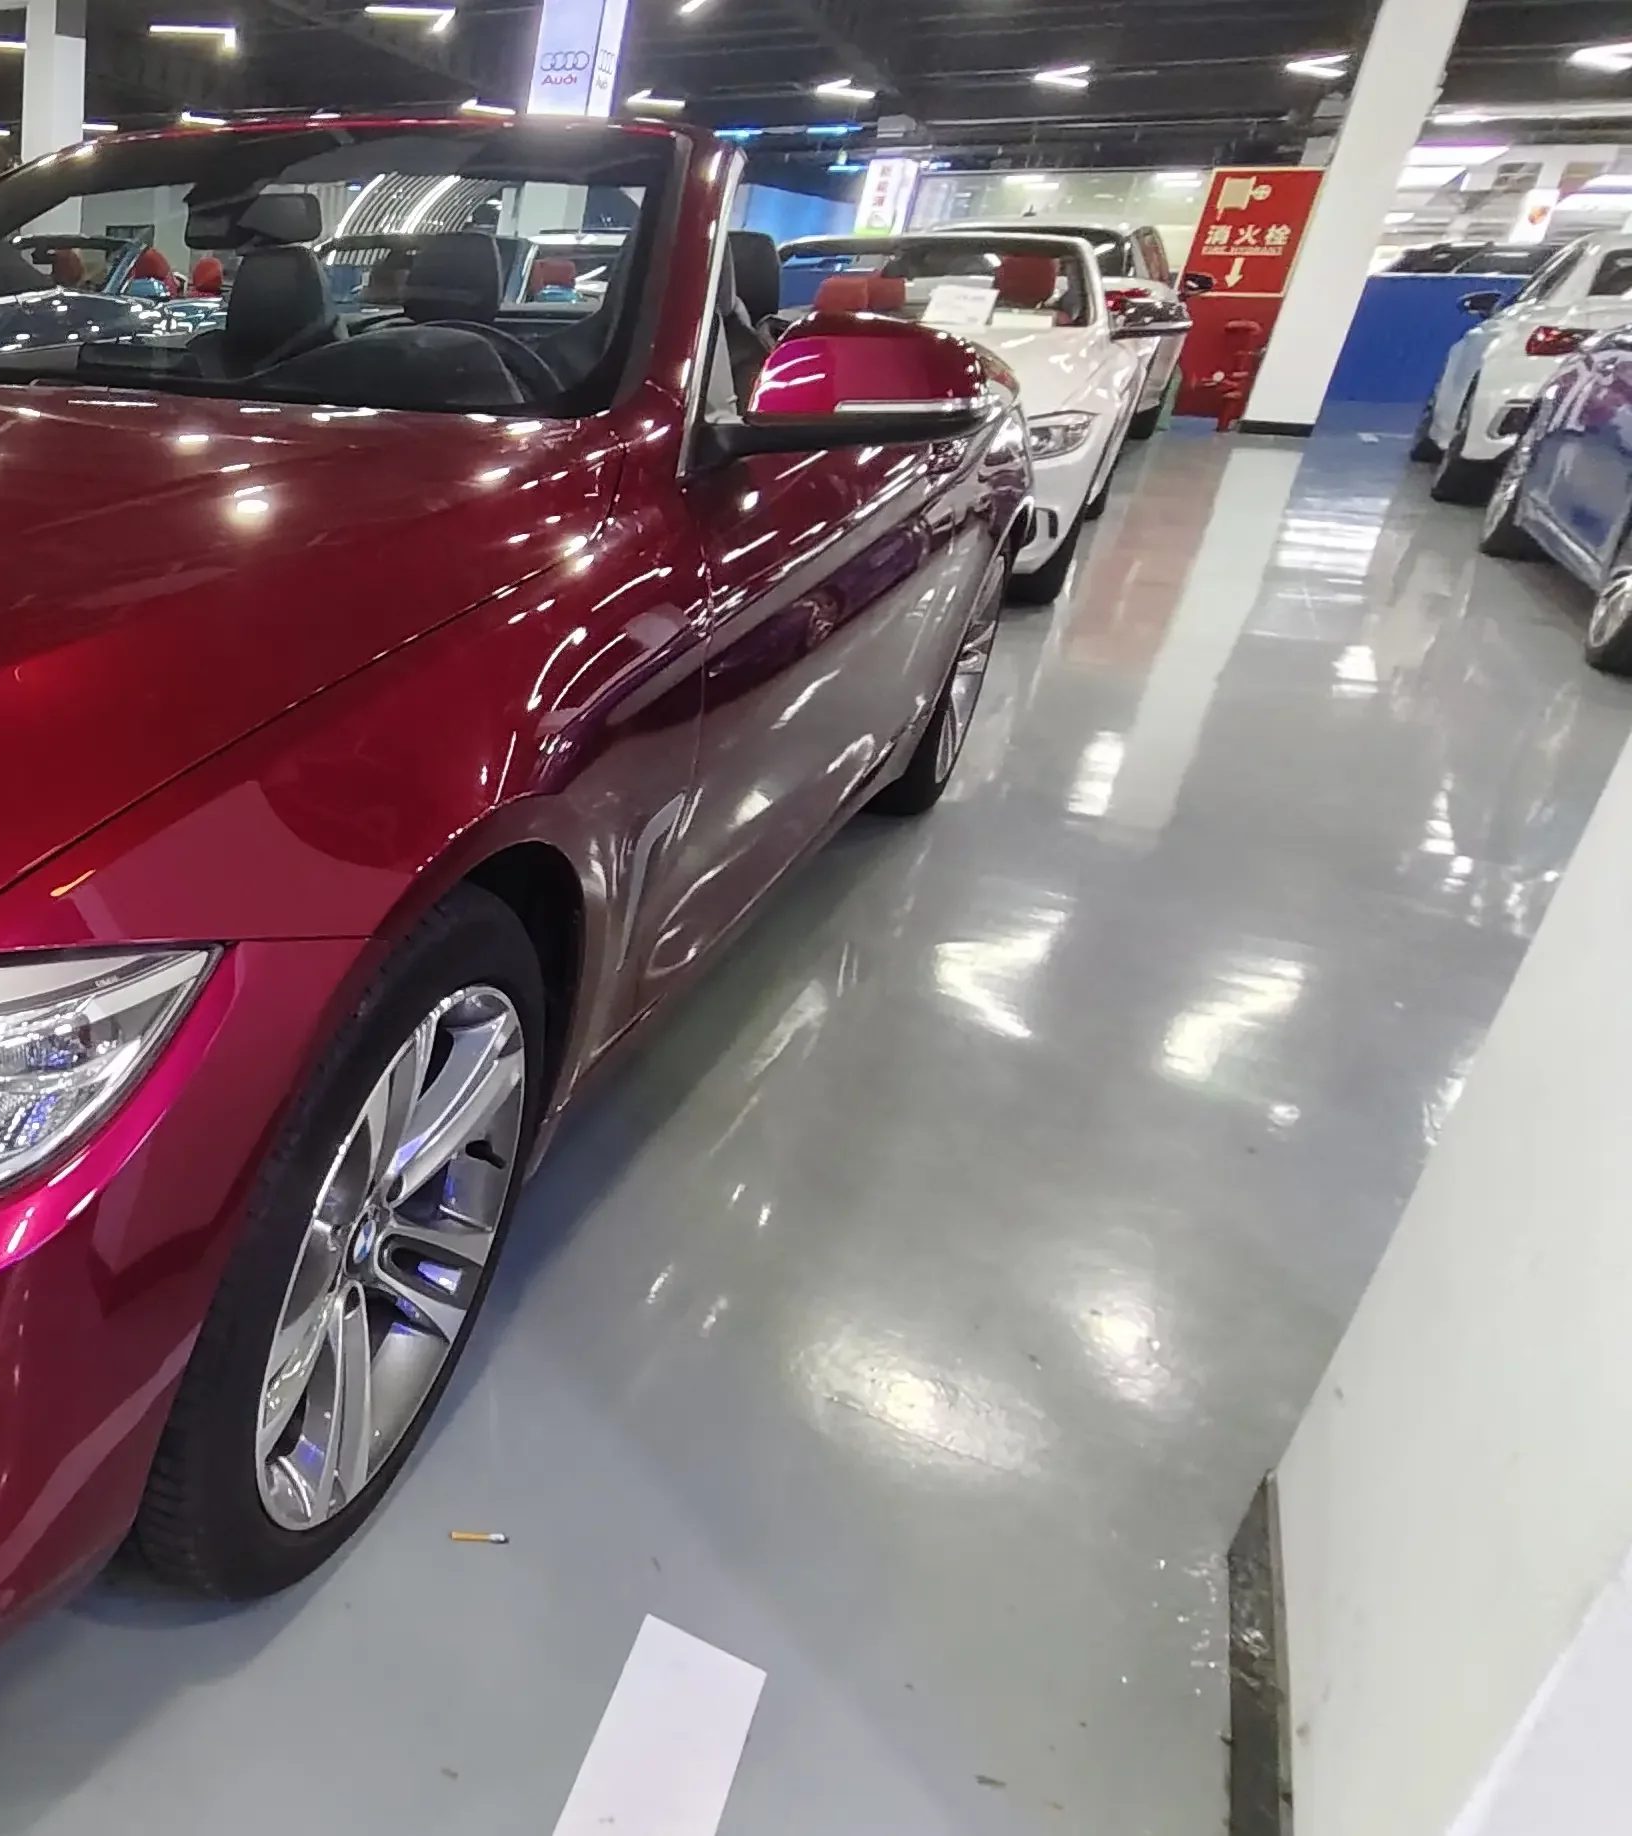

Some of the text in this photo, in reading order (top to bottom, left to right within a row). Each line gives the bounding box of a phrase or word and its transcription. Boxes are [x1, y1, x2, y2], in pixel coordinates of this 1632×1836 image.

[541, 74, 578, 86] Audi
[1204, 223, 1292, 246] 消火栓
